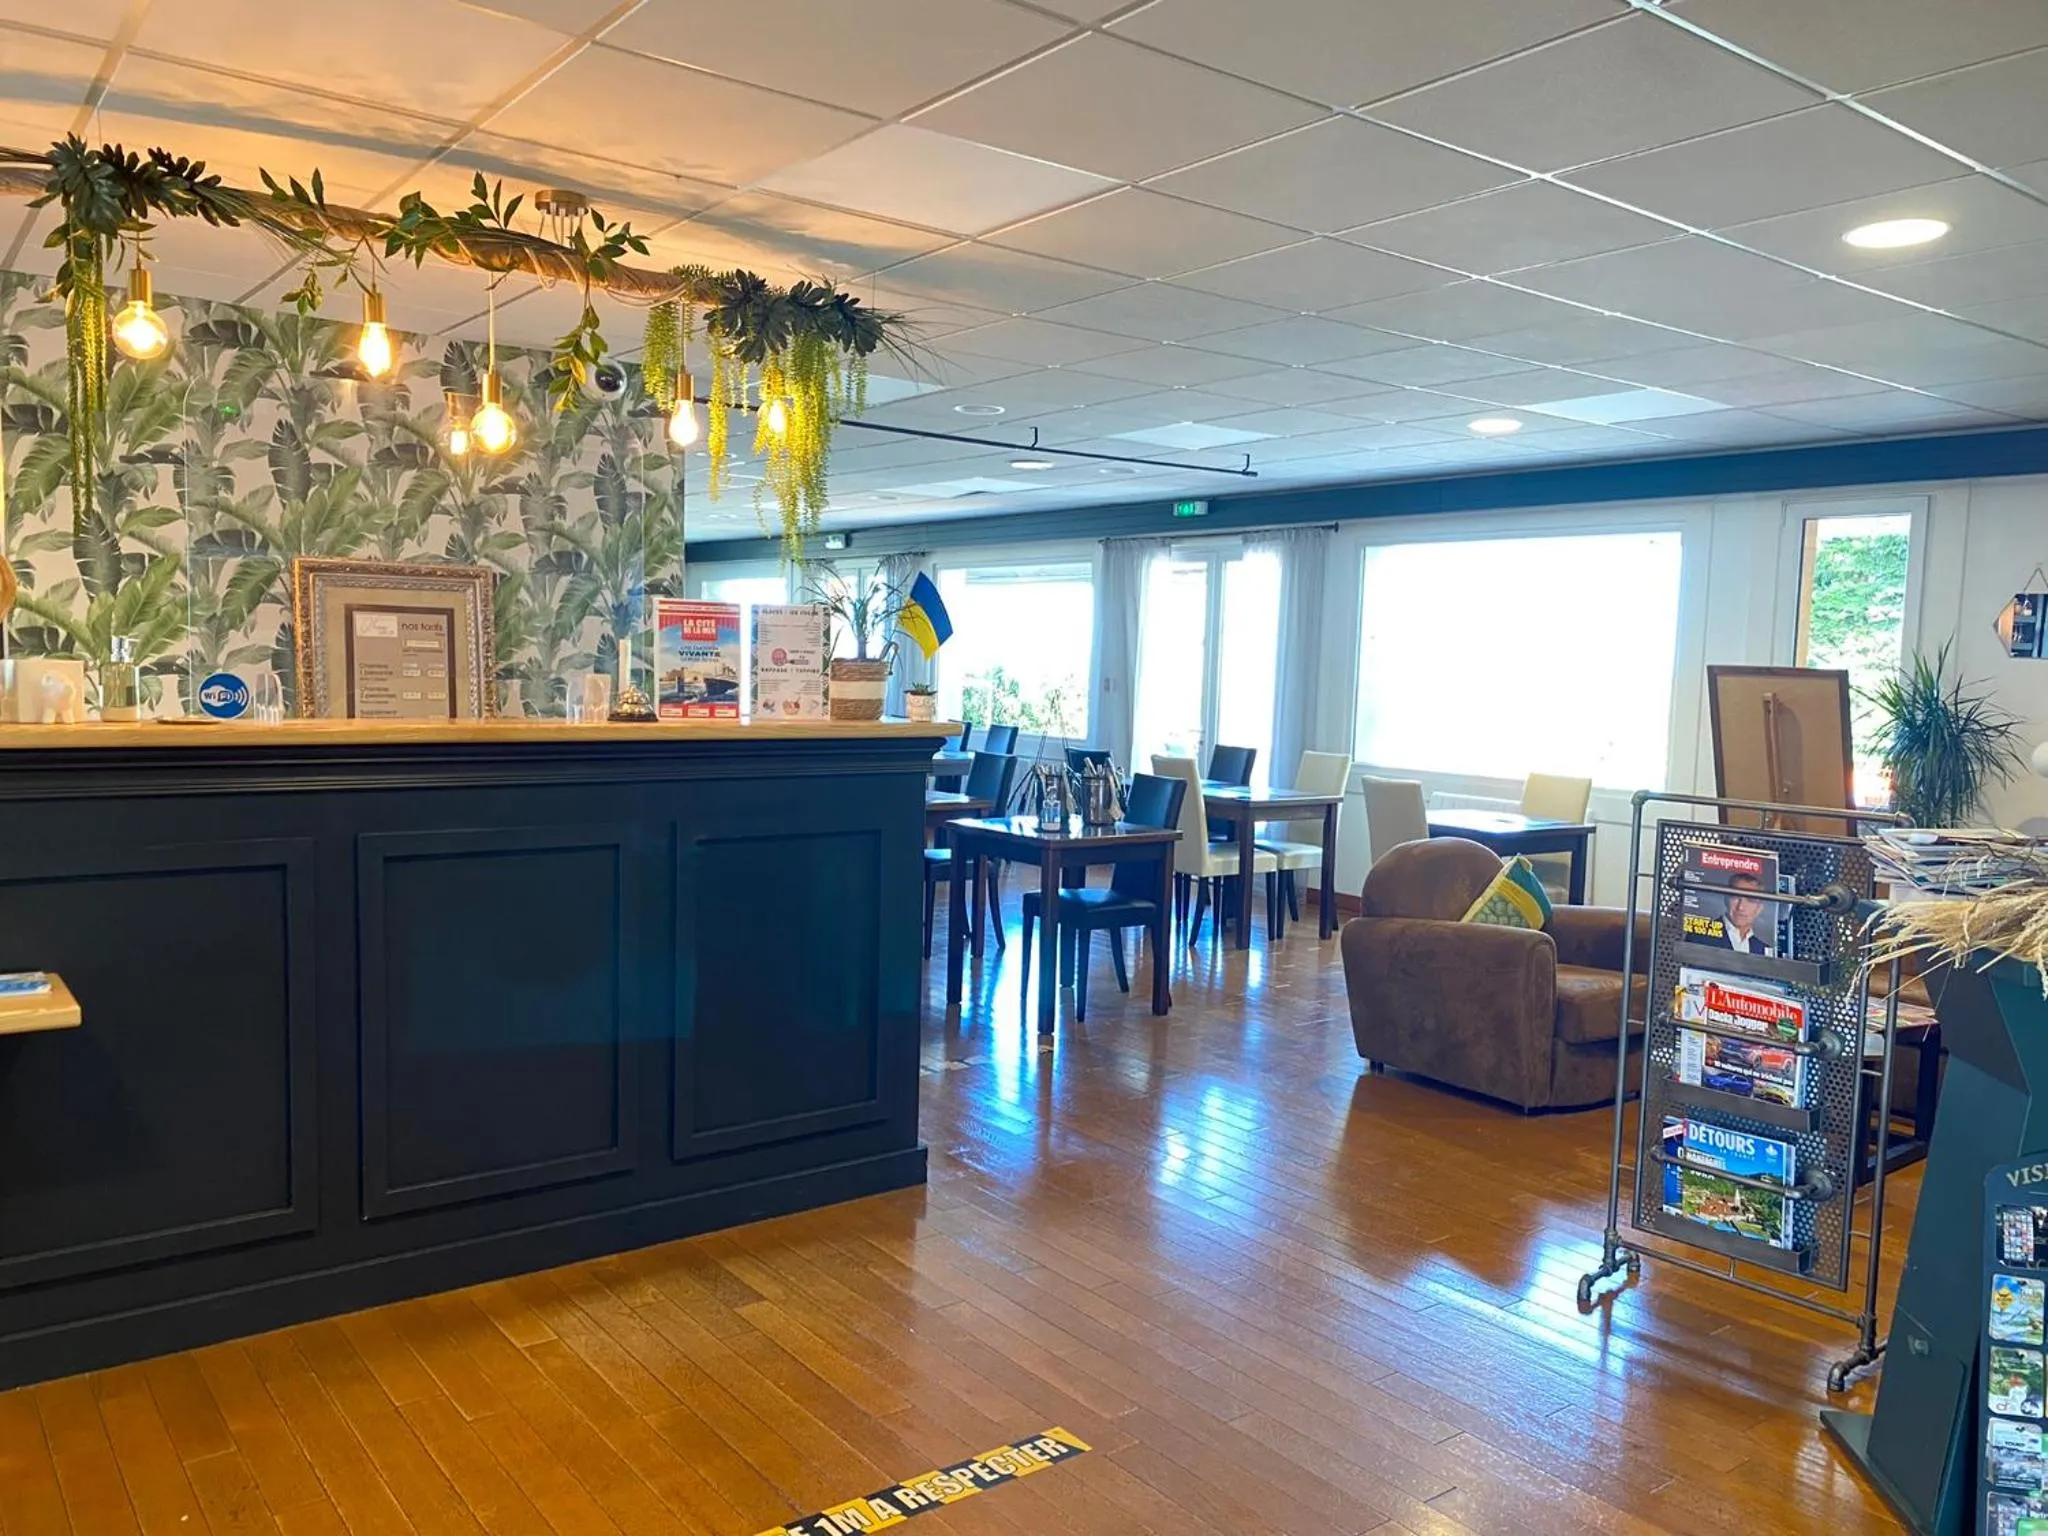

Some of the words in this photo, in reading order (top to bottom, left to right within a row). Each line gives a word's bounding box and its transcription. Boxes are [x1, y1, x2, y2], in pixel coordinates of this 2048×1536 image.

[1702, 852, 1760, 871] Entreprendre
[1710, 990, 1799, 1021] L'Automobile
[868, 1498, 902, 1521] A
[893, 1437, 1069, 1510] RESPECTER
